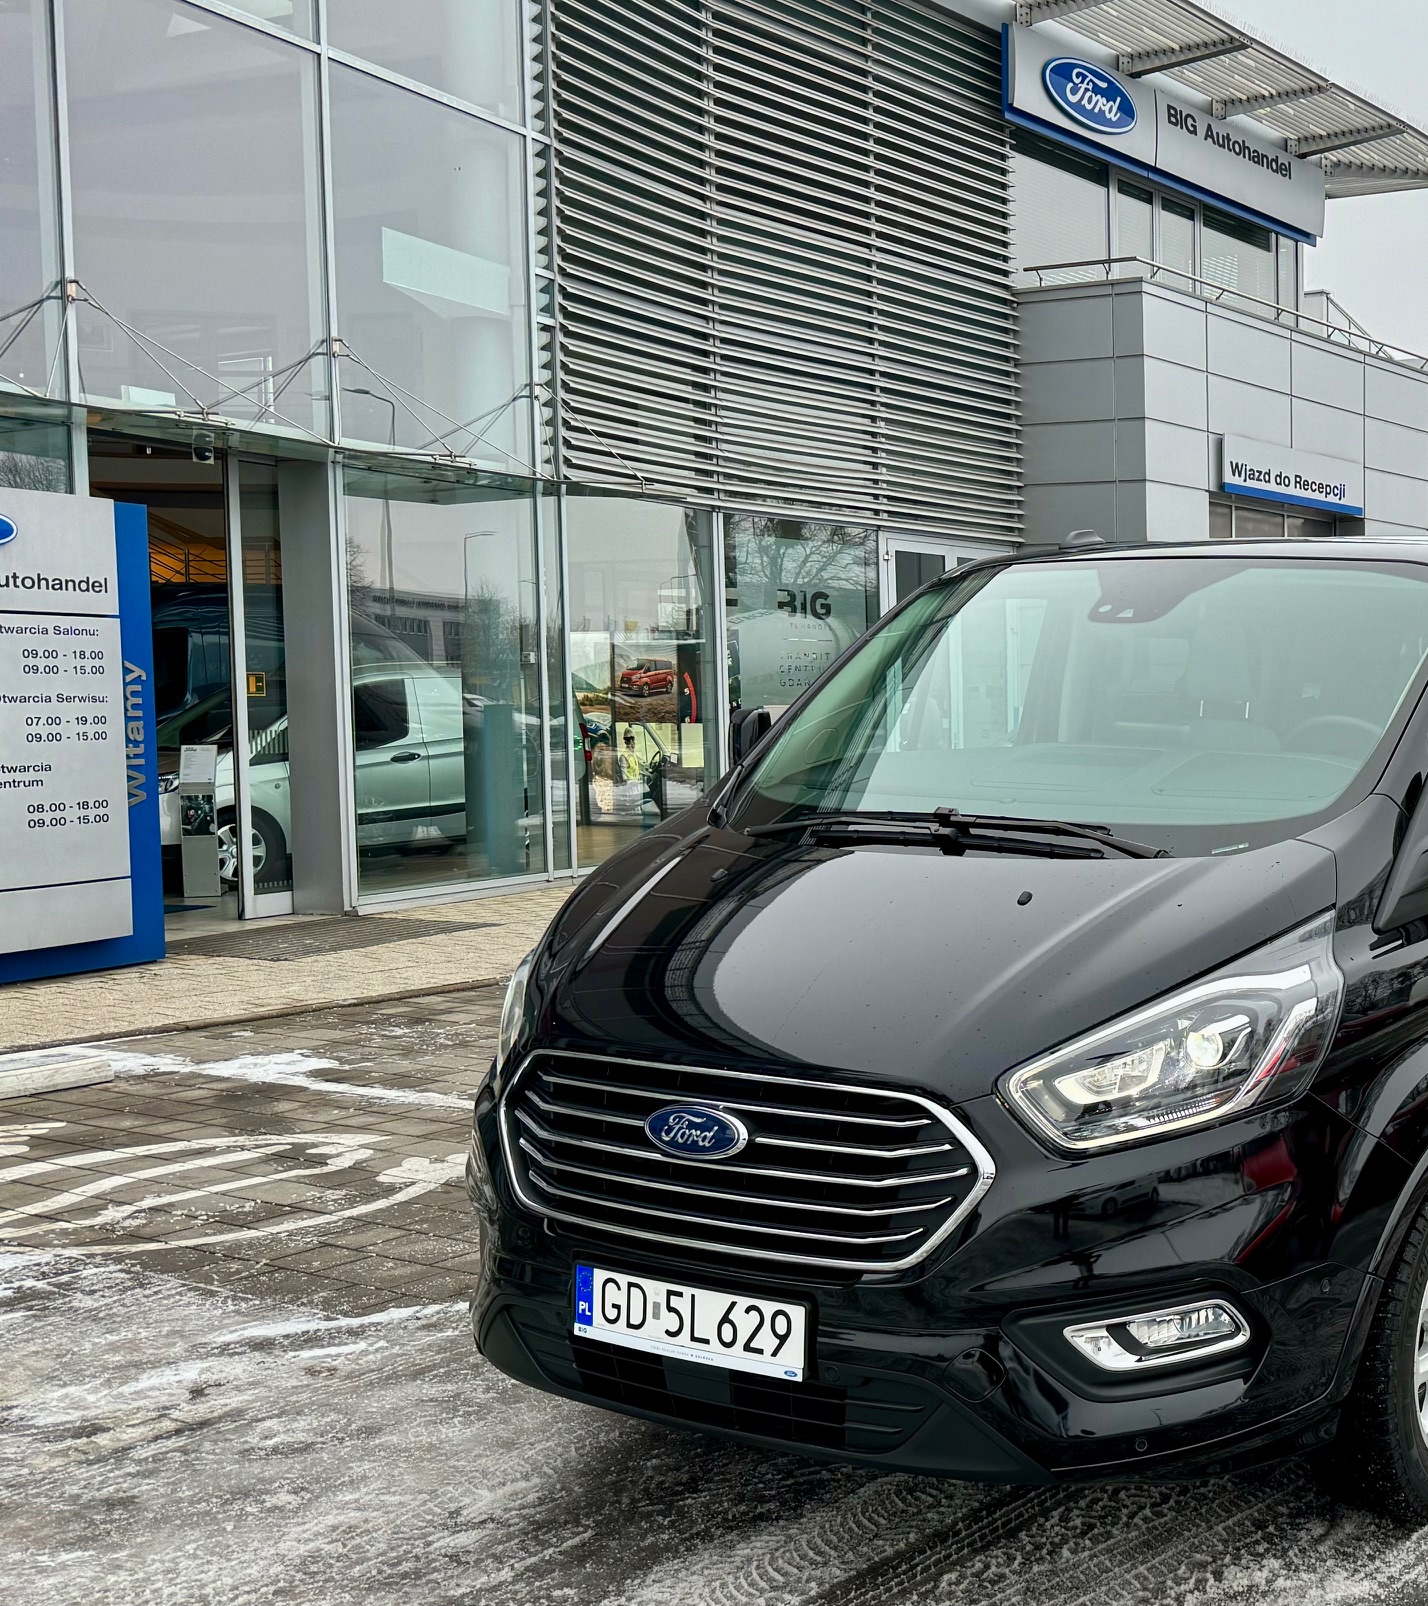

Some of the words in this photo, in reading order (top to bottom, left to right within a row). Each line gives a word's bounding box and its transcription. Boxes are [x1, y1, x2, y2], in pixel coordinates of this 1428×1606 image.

[1066, 68, 1121, 122] Ford
[1166, 103, 1198, 137] BIG
[1203, 123, 1292, 180] Autohandel
[1230, 461, 1271, 484] Wjazd
[1274, 471, 1291, 488] do
[1294, 475, 1346, 501] Recepcji
[776, 589, 832, 620] BIG
[53, 625, 99, 637] Salonu:
[22, 648, 59, 660] 09.00
[72, 650, 104, 660] 18.00
[22, 664, 59, 675] 09.00
[73, 665, 105, 675] 15.00
[56, 693, 109, 703] Serwisu:
[25, 716, 62, 726] 07.00
[75, 716, 107, 726] 19.00
[26, 733, 62, 743] 09.00
[76, 731, 108, 741] 15.00
[123, 661, 147, 808] Witamy
[0, 762, 52, 773] twarcia
[27, 802, 66, 814] 08.00
[76, 800, 109, 810] 18.00
[27, 817, 67, 828] 09.00
[77, 814, 109, 825] 15.00
[661, 1113, 719, 1148] Ford
[578, 1301, 592, 1316] PL
[601, 1277, 648, 1331] GD
[664, 1288, 793, 1358] 5L629
